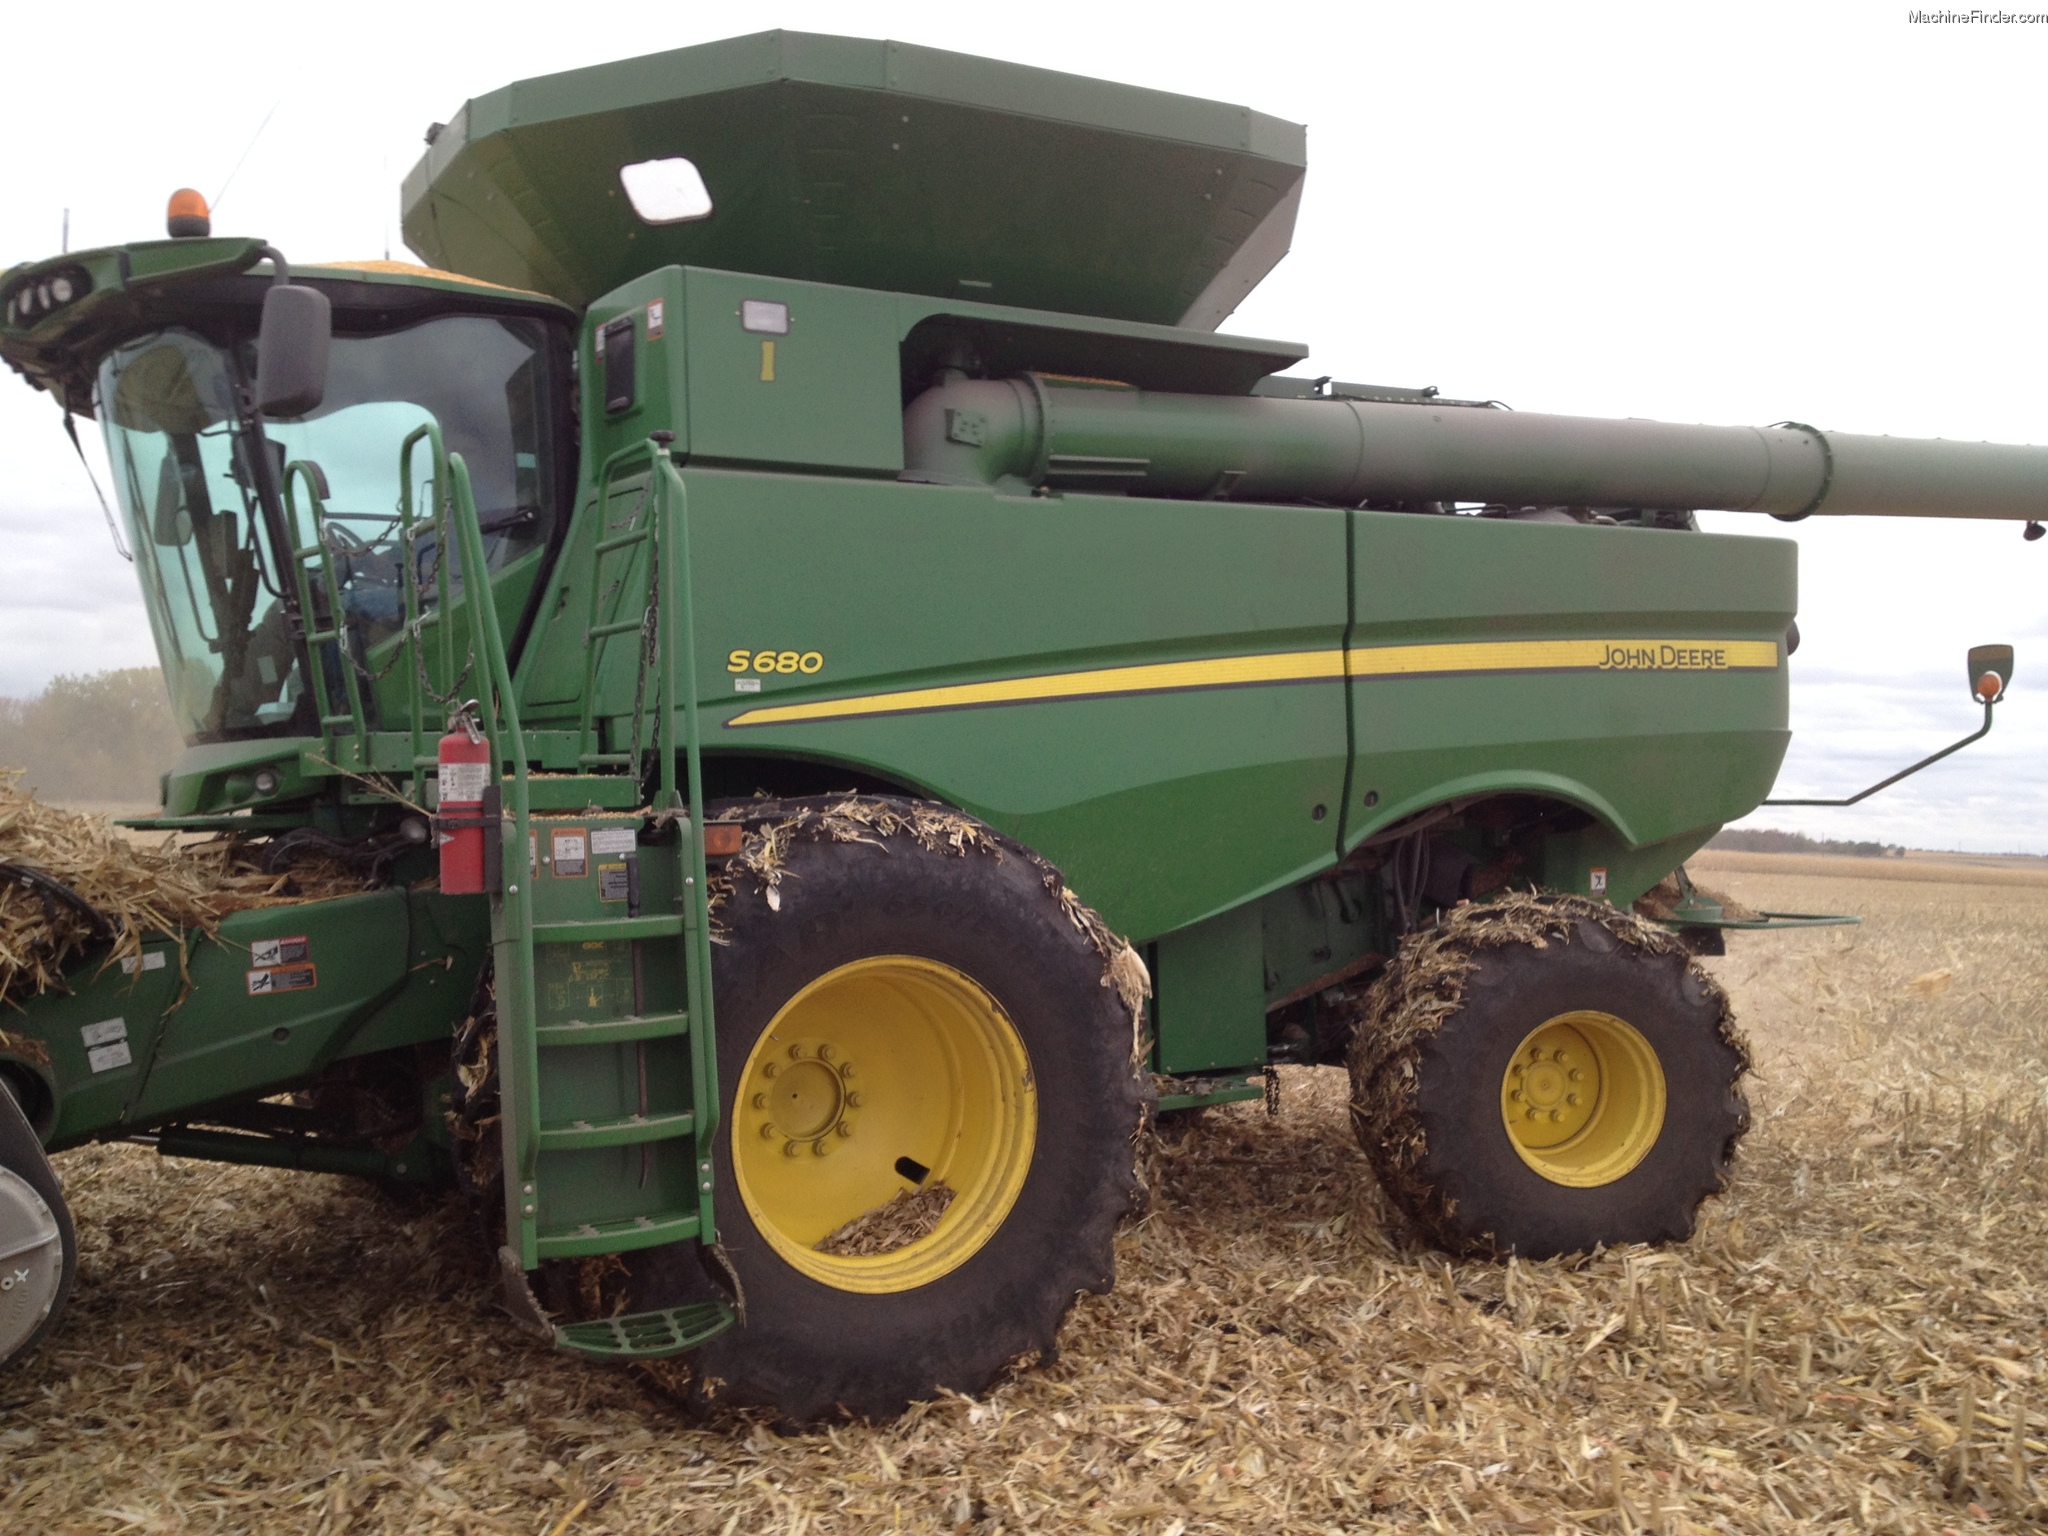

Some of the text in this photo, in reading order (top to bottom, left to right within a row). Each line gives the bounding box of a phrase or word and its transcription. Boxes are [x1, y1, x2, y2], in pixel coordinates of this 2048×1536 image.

[726, 648, 824, 674] S680
[1599, 644, 1726, 667] JOHN DEERE
